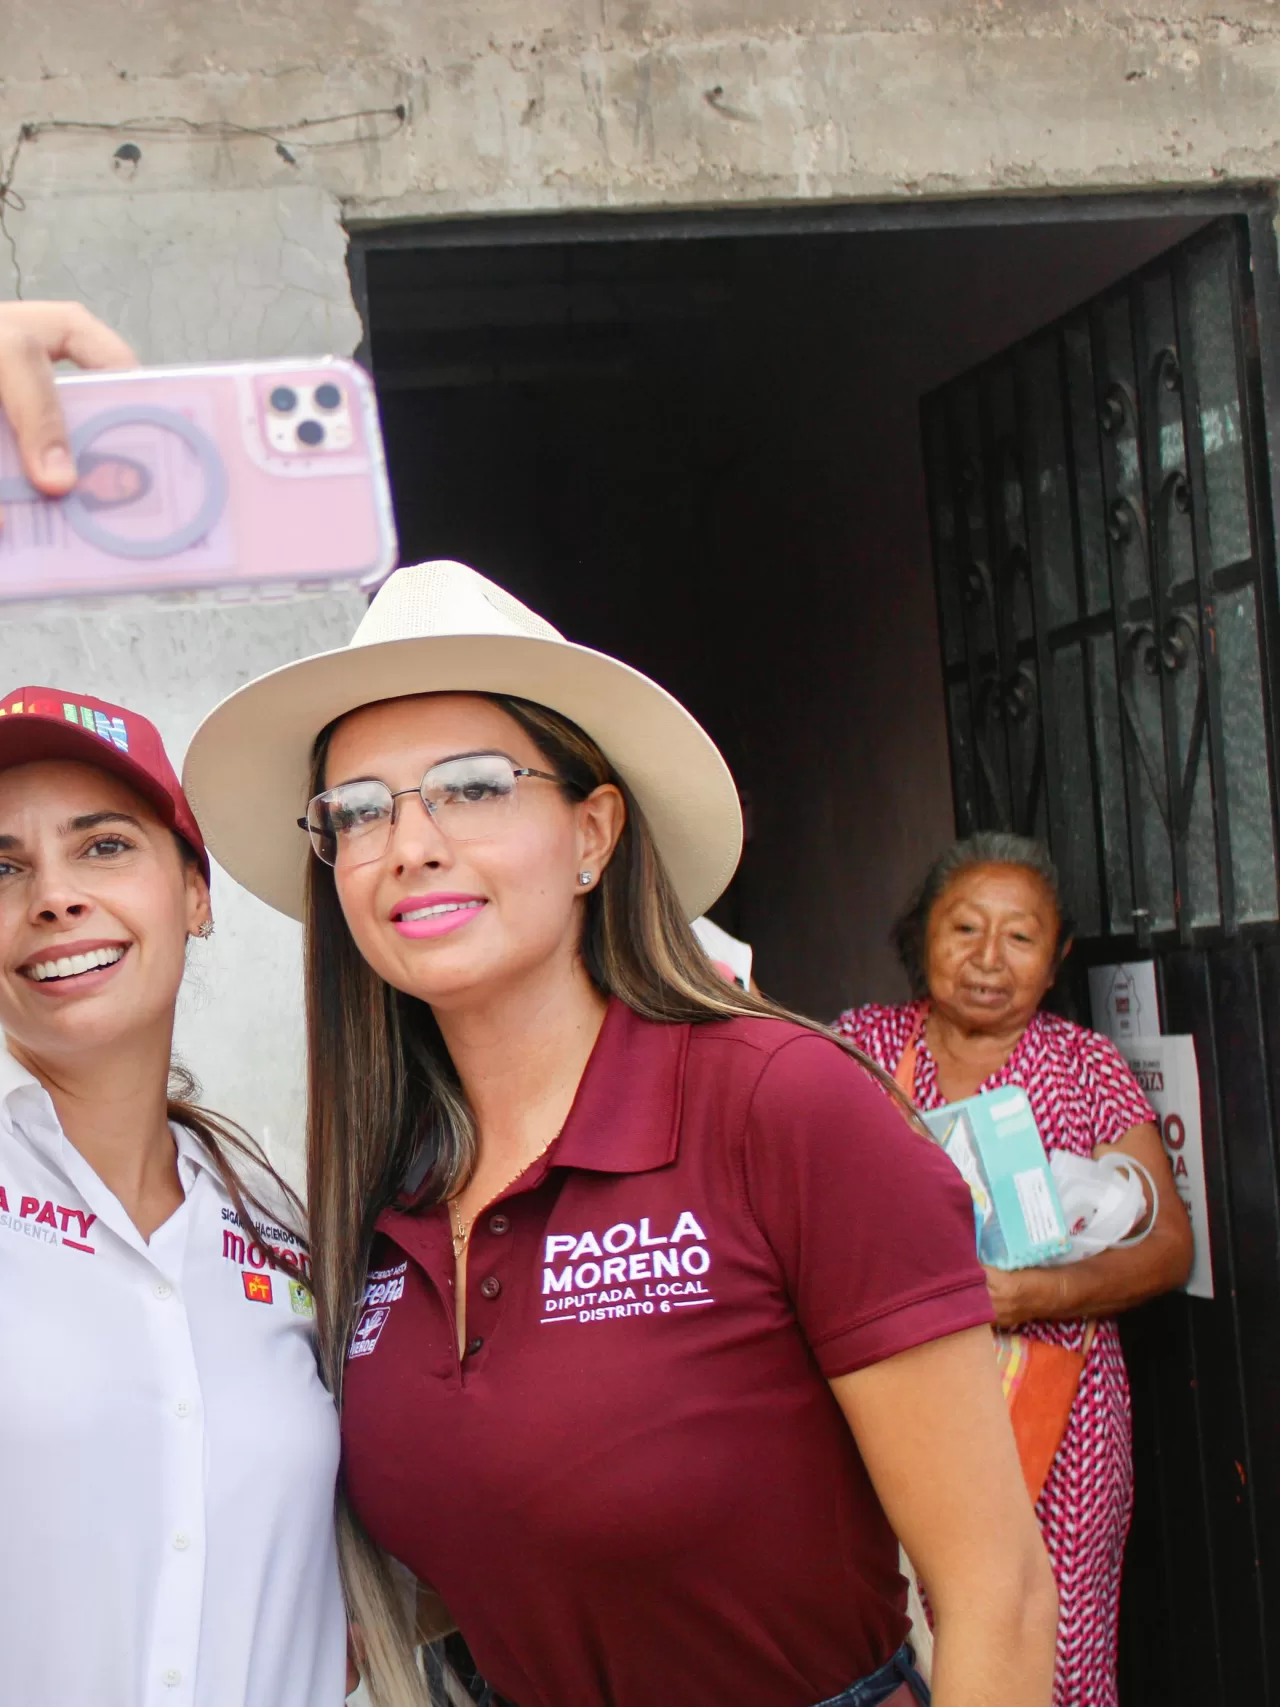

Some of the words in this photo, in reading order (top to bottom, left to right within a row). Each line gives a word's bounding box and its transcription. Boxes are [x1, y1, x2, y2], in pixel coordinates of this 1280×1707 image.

[1134, 1072, 1163, 1091] OTA
[19, 1196, 98, 1238] PATY
[544, 1211, 707, 1263] PAOLA
[222, 1229, 313, 1280] moren
[542, 1245, 710, 1295] MORENO
[248, 1282, 269, 1299] PT
[361, 1275, 405, 1306] rena
[545, 1287, 636, 1312] DIPUTADA
[644, 1281, 709, 1297] LOCAL
[579, 1301, 654, 1323] DISTRITO
[659, 1301, 671, 1313] 6
